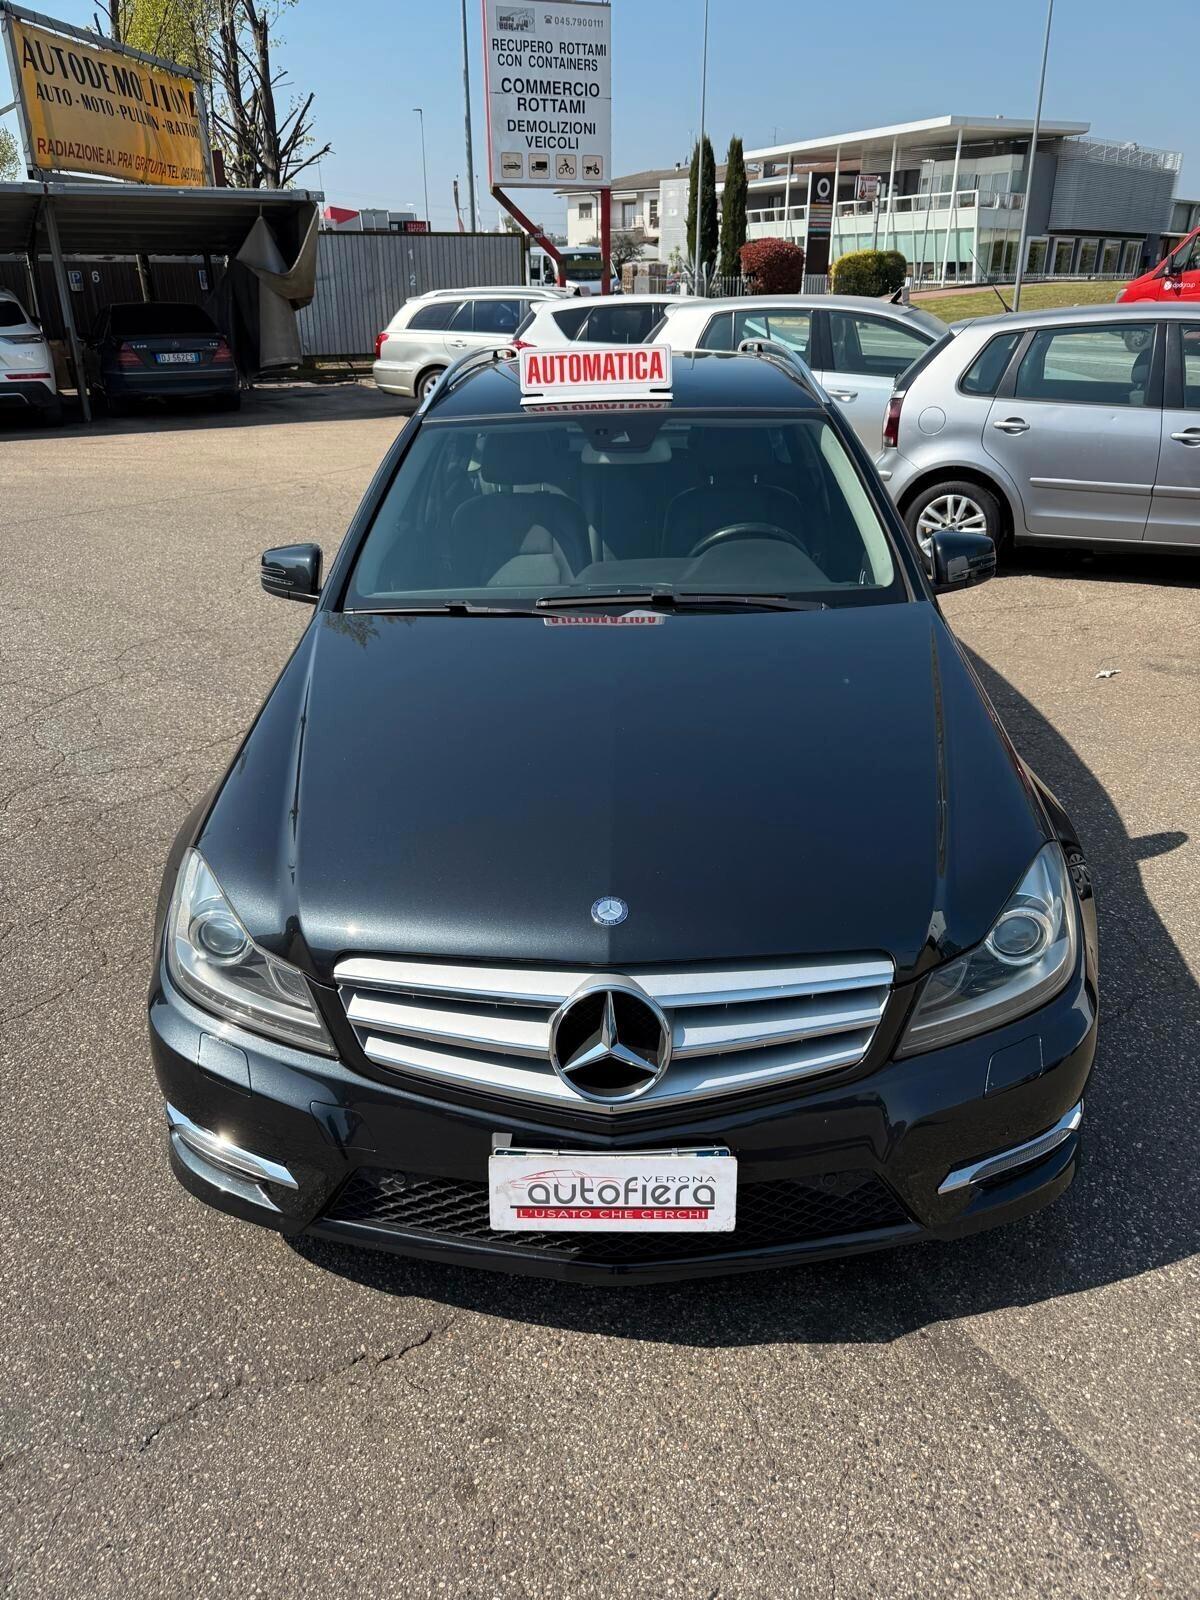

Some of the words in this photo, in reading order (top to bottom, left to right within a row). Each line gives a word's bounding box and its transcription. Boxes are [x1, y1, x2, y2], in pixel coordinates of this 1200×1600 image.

[492, 38, 553, 53] RECUPERO
[559, 41, 607, 56] ROTTAMI
[497, 53, 522, 67] CON
[528, 55, 598, 71] CONTAINERS
[501, 77, 600, 97] COMMERCIO
[36, 82, 72, 106] AUTO
[80, 93, 115, 117] MOTO
[517, 97, 586, 114] ROTTAMI
[507, 119, 596, 135] DEMOLIZIONI
[525, 135, 579, 150] VEICOLI
[37, 137, 105, 163] RADIAZIONE
[106, 148, 116, 166] AL
[407, 249, 414, 260] 1
[91, 271, 100, 283] 6
[410, 274, 417, 286] 2
[527, 351, 663, 385] AUTOMATICA
[641, 1175, 717, 1183] VERONA
[527, 1176, 716, 1205] autofiera
[518, 1209, 592, 1219] L'USATO
[599, 1209, 634, 1219] CHE
[639, 1209, 707, 1219] CERCHI
